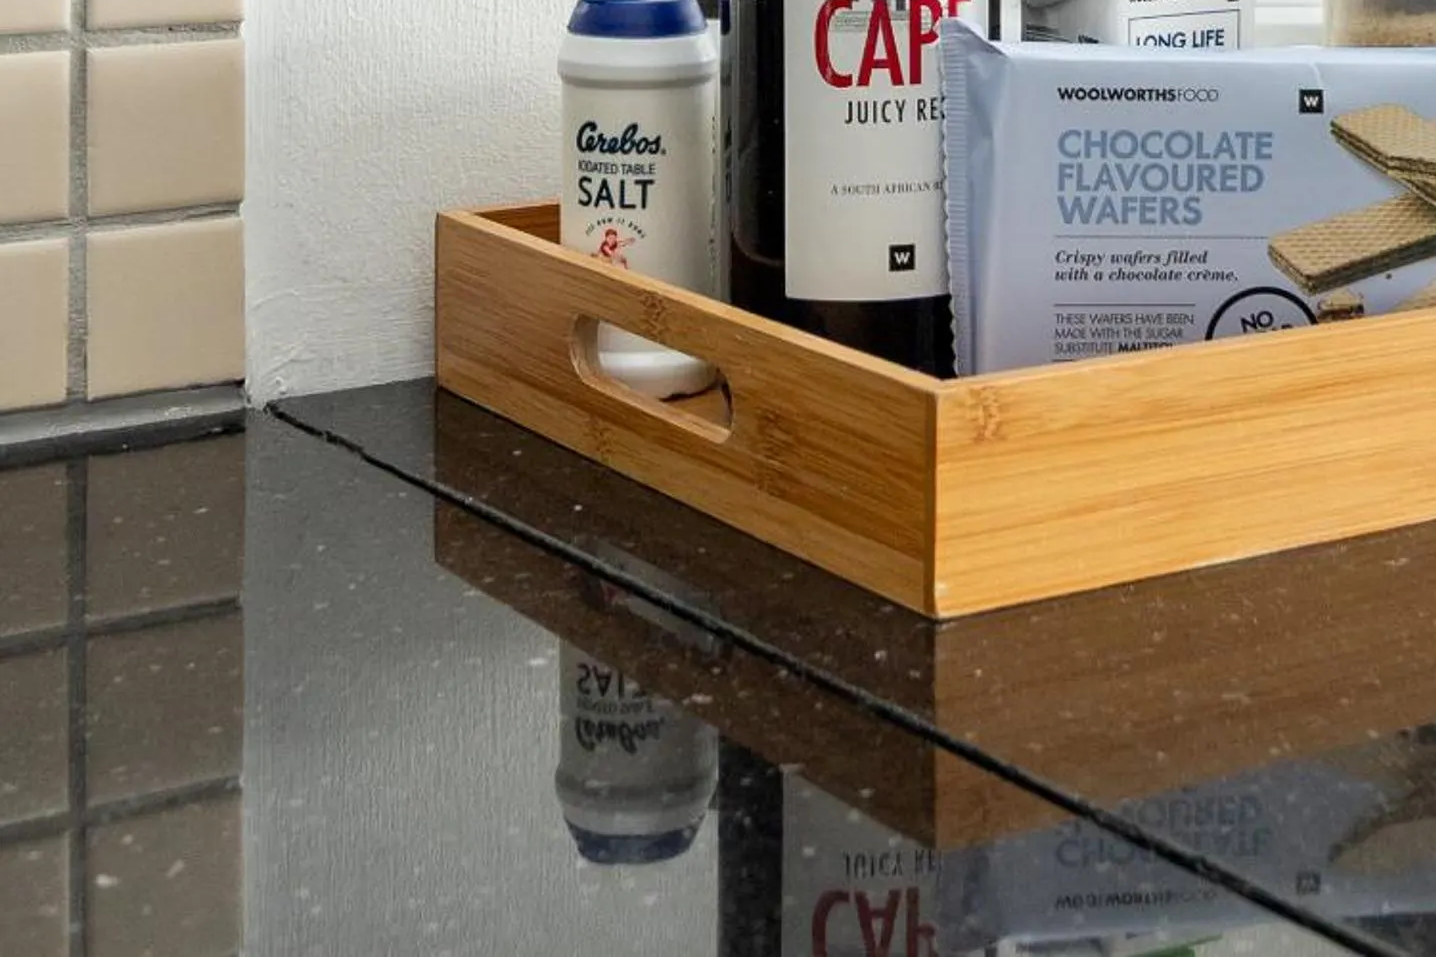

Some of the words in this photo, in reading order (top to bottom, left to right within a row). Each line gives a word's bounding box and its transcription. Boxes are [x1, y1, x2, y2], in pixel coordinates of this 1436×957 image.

[1136, 31, 1187, 48] LONG
[1192, 29, 1225, 48] LIFE
[845, 99, 906, 124] JUICY
[576, 121, 662, 155] Cerebos
[1057, 129, 1273, 160] CHOCOLATE
[621, 163, 656, 175] TABLE
[1057, 162, 1264, 193] FLAVOURED
[578, 176, 655, 209] SALT
[1057, 196, 1203, 226] WAFERS
[1055, 250, 1105, 267] Crispy
[1110, 250, 1161, 267] wafers
[1163, 249, 1209, 267] filled
[1055, 267, 1089, 281] with
[1093, 271, 1102, 281] a
[1108, 267, 1183, 281] chocolate
[1187, 269, 1239, 282] crème.
[1054, 313, 1086, 325] THESE
[1088, 313, 1133, 325] WAFERS
[1135, 313, 1164, 325] HAVE
[1166, 313, 1194, 325] BEEN
[1241, 310, 1274, 333] NO
[1054, 327, 1086, 339] MADE
[1088, 327, 1119, 339] WITH
[1123, 327, 1142, 339] THE
[1145, 327, 1184, 339] SUGAR
